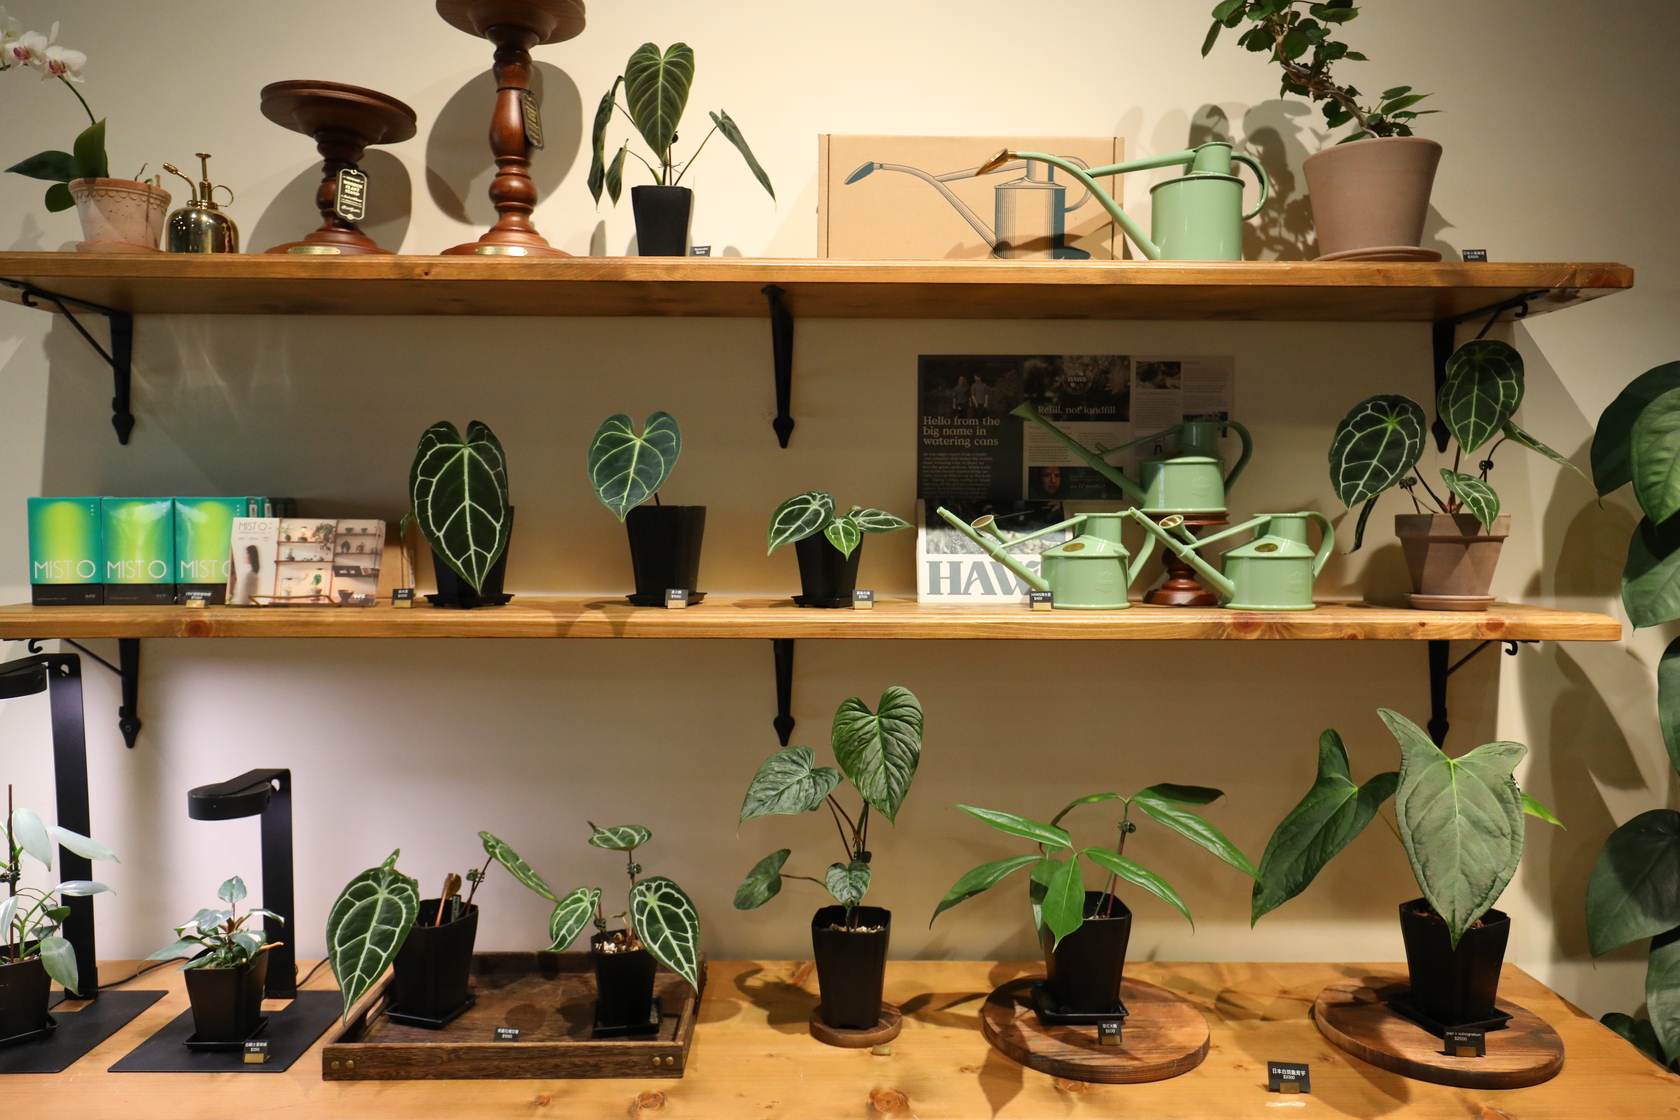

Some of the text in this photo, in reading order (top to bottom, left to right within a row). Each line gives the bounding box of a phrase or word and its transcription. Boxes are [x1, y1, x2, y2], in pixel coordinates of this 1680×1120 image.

[1065, 406, 1082, 414] not
[1084, 405, 1116, 414] landfill
[923, 416, 1001, 425] Hello from the
[923, 426, 987, 438] big name in
[923, 436, 999, 448] watering cans
[926, 560, 1041, 595] HAW
